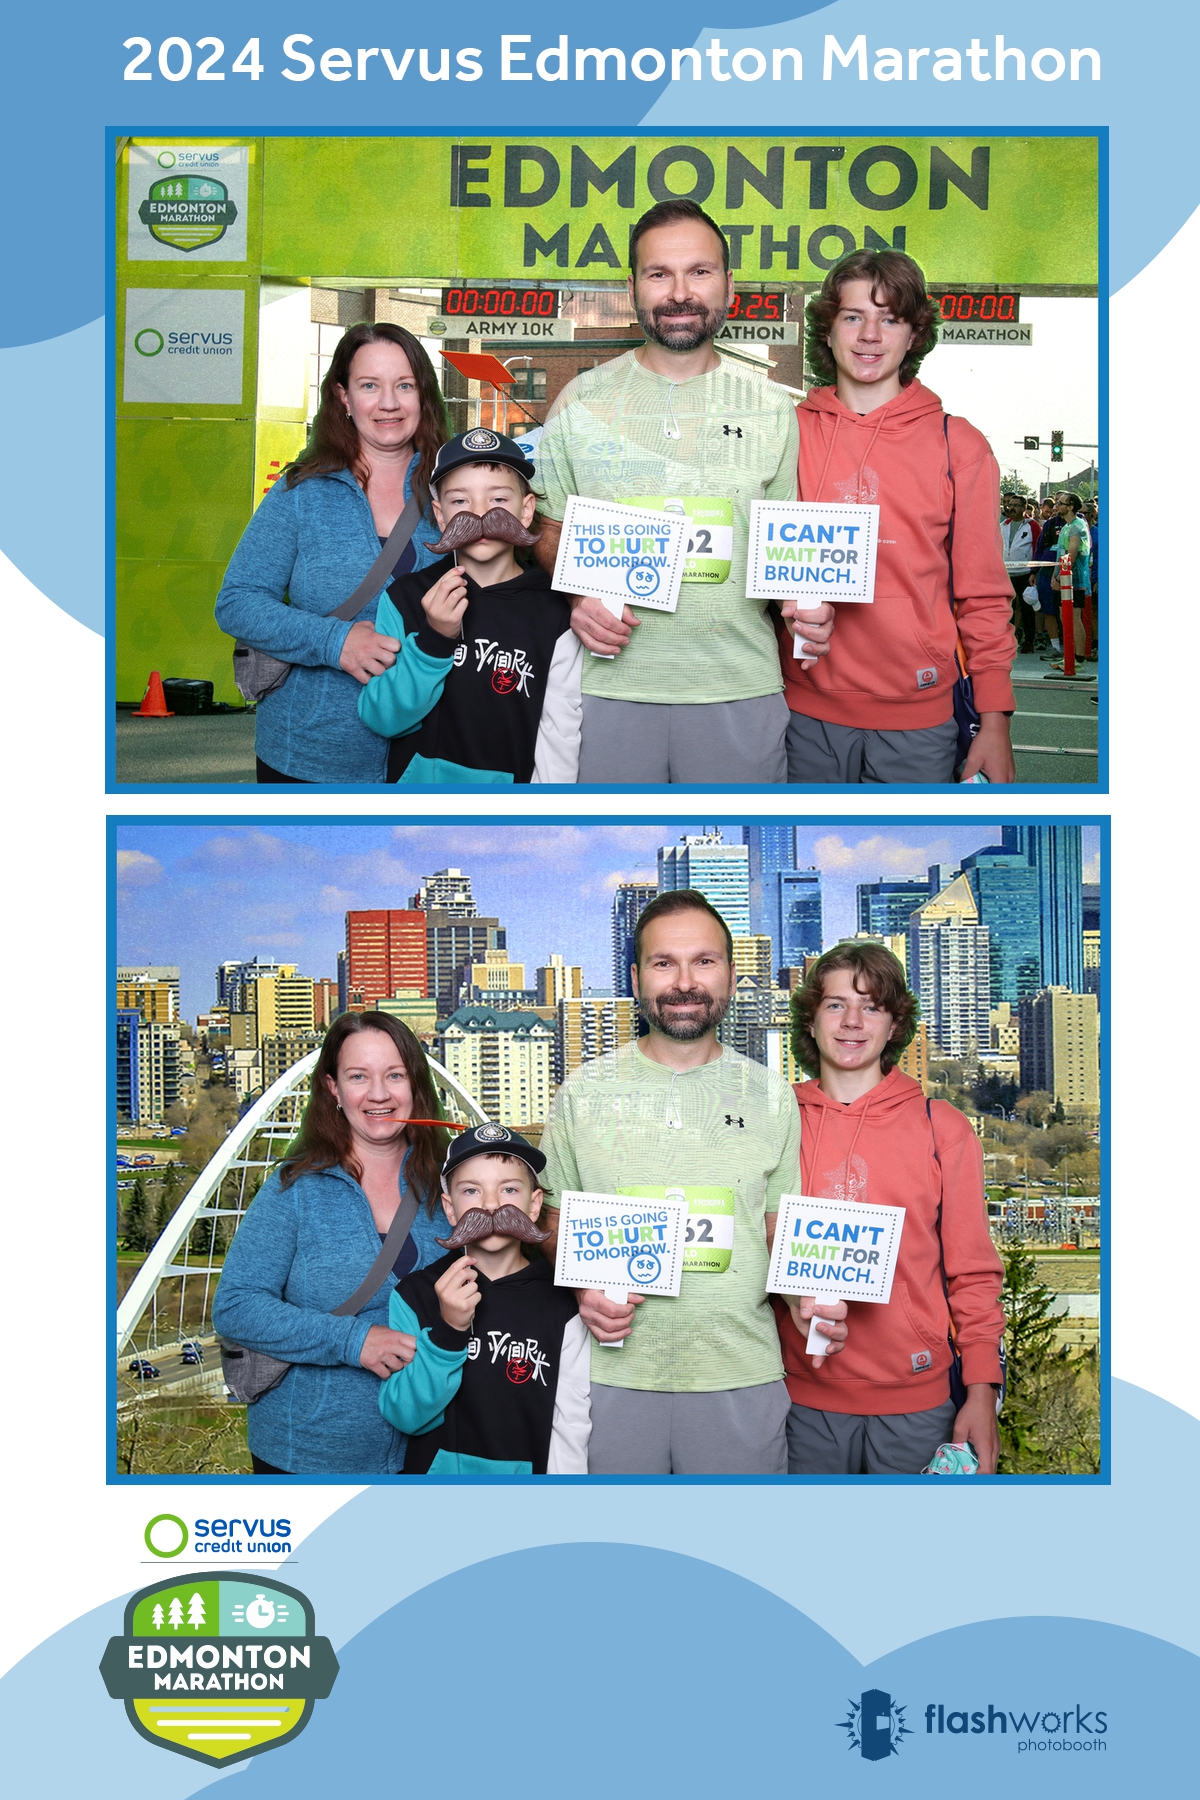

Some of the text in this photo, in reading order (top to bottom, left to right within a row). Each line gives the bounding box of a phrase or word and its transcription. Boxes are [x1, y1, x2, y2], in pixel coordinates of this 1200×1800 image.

[178, 152, 220, 161] servus
[450, 145, 990, 211] EDMONTON
[149, 203, 227, 214] EDMONTON
[160, 214, 215, 222] MARATHON
[523, 223, 907, 270] MATHON
[466, 321, 554, 336] ARMY 10K
[714, 325, 785, 340] ATHON
[942, 329, 1031, 341] MARATHON
[168, 332, 233, 345] servus
[168, 345, 233, 355] credit union
[573, 524, 671, 536] THIS IS GOING
[767, 522, 860, 545] I CAN'T
[575, 537, 670, 554] TO HURT
[573, 556, 671, 568] TOMORROW.
[765, 546, 859, 565] WAIT FOR
[682, 571, 720, 579] MARATHON
[764, 565, 856, 584] BRUNCH.
[569, 1211, 668, 1230] THIS IS GOING
[572, 1224, 668, 1248] TO HURT
[793, 1218, 885, 1245] I CAN'T
[573, 1242, 671, 1262] TOMORROW.
[790, 1241, 880, 1265] WAIT FOR
[786, 1260, 875, 1285] BRUNCH.
